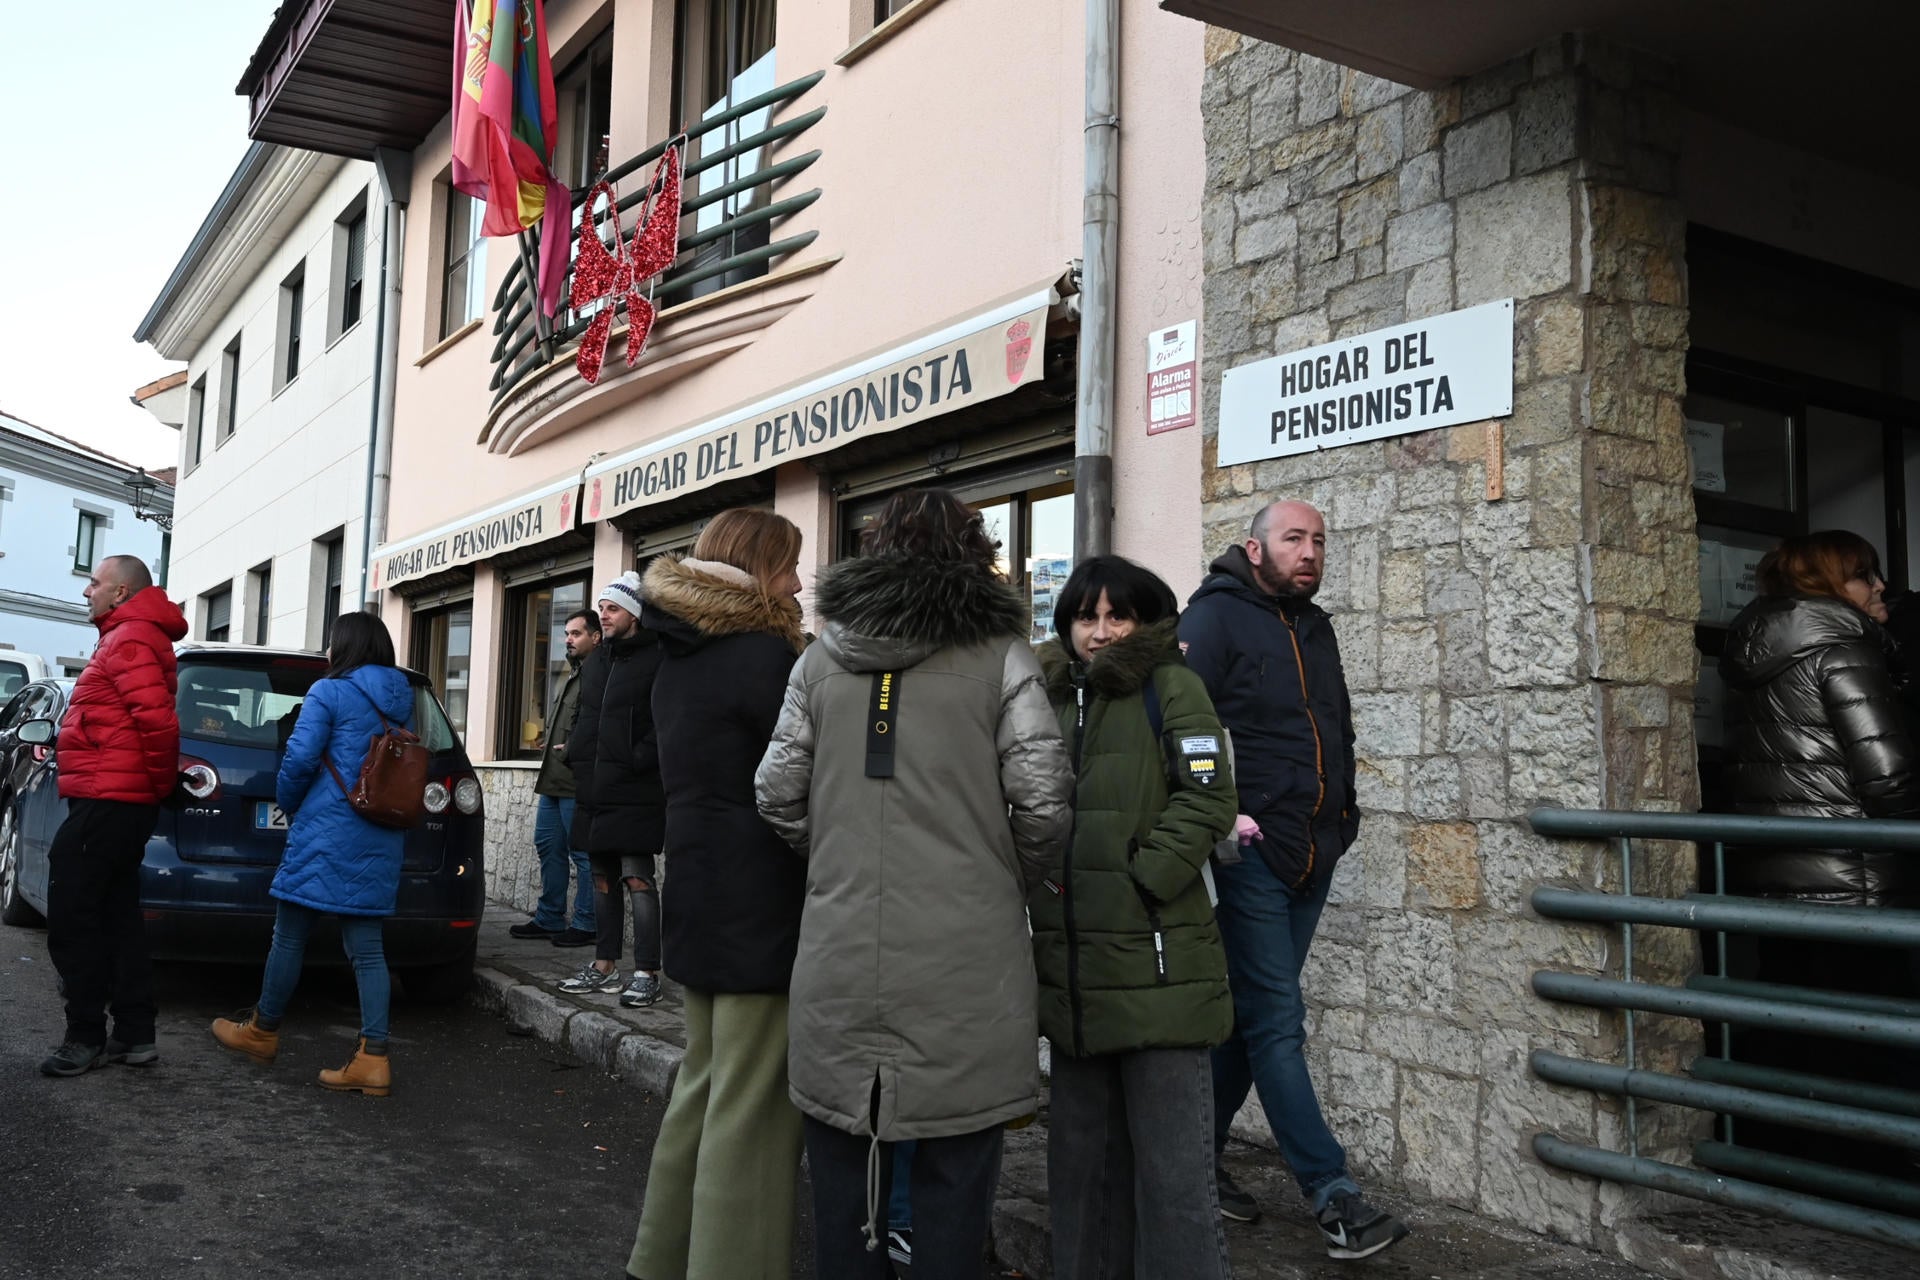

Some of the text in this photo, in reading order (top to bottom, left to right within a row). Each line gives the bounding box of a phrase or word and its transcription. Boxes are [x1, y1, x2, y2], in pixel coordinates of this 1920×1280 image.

[1151, 368, 1191, 389] Alarma
[1281, 330, 1434, 398] HOGAR DEL
[613, 348, 972, 508] HOGAR DEL PENSIONISTA
[1271, 375, 1454, 444] PENSIONISTA
[387, 505, 543, 581] HOGAR DEL PENSIONISTA
